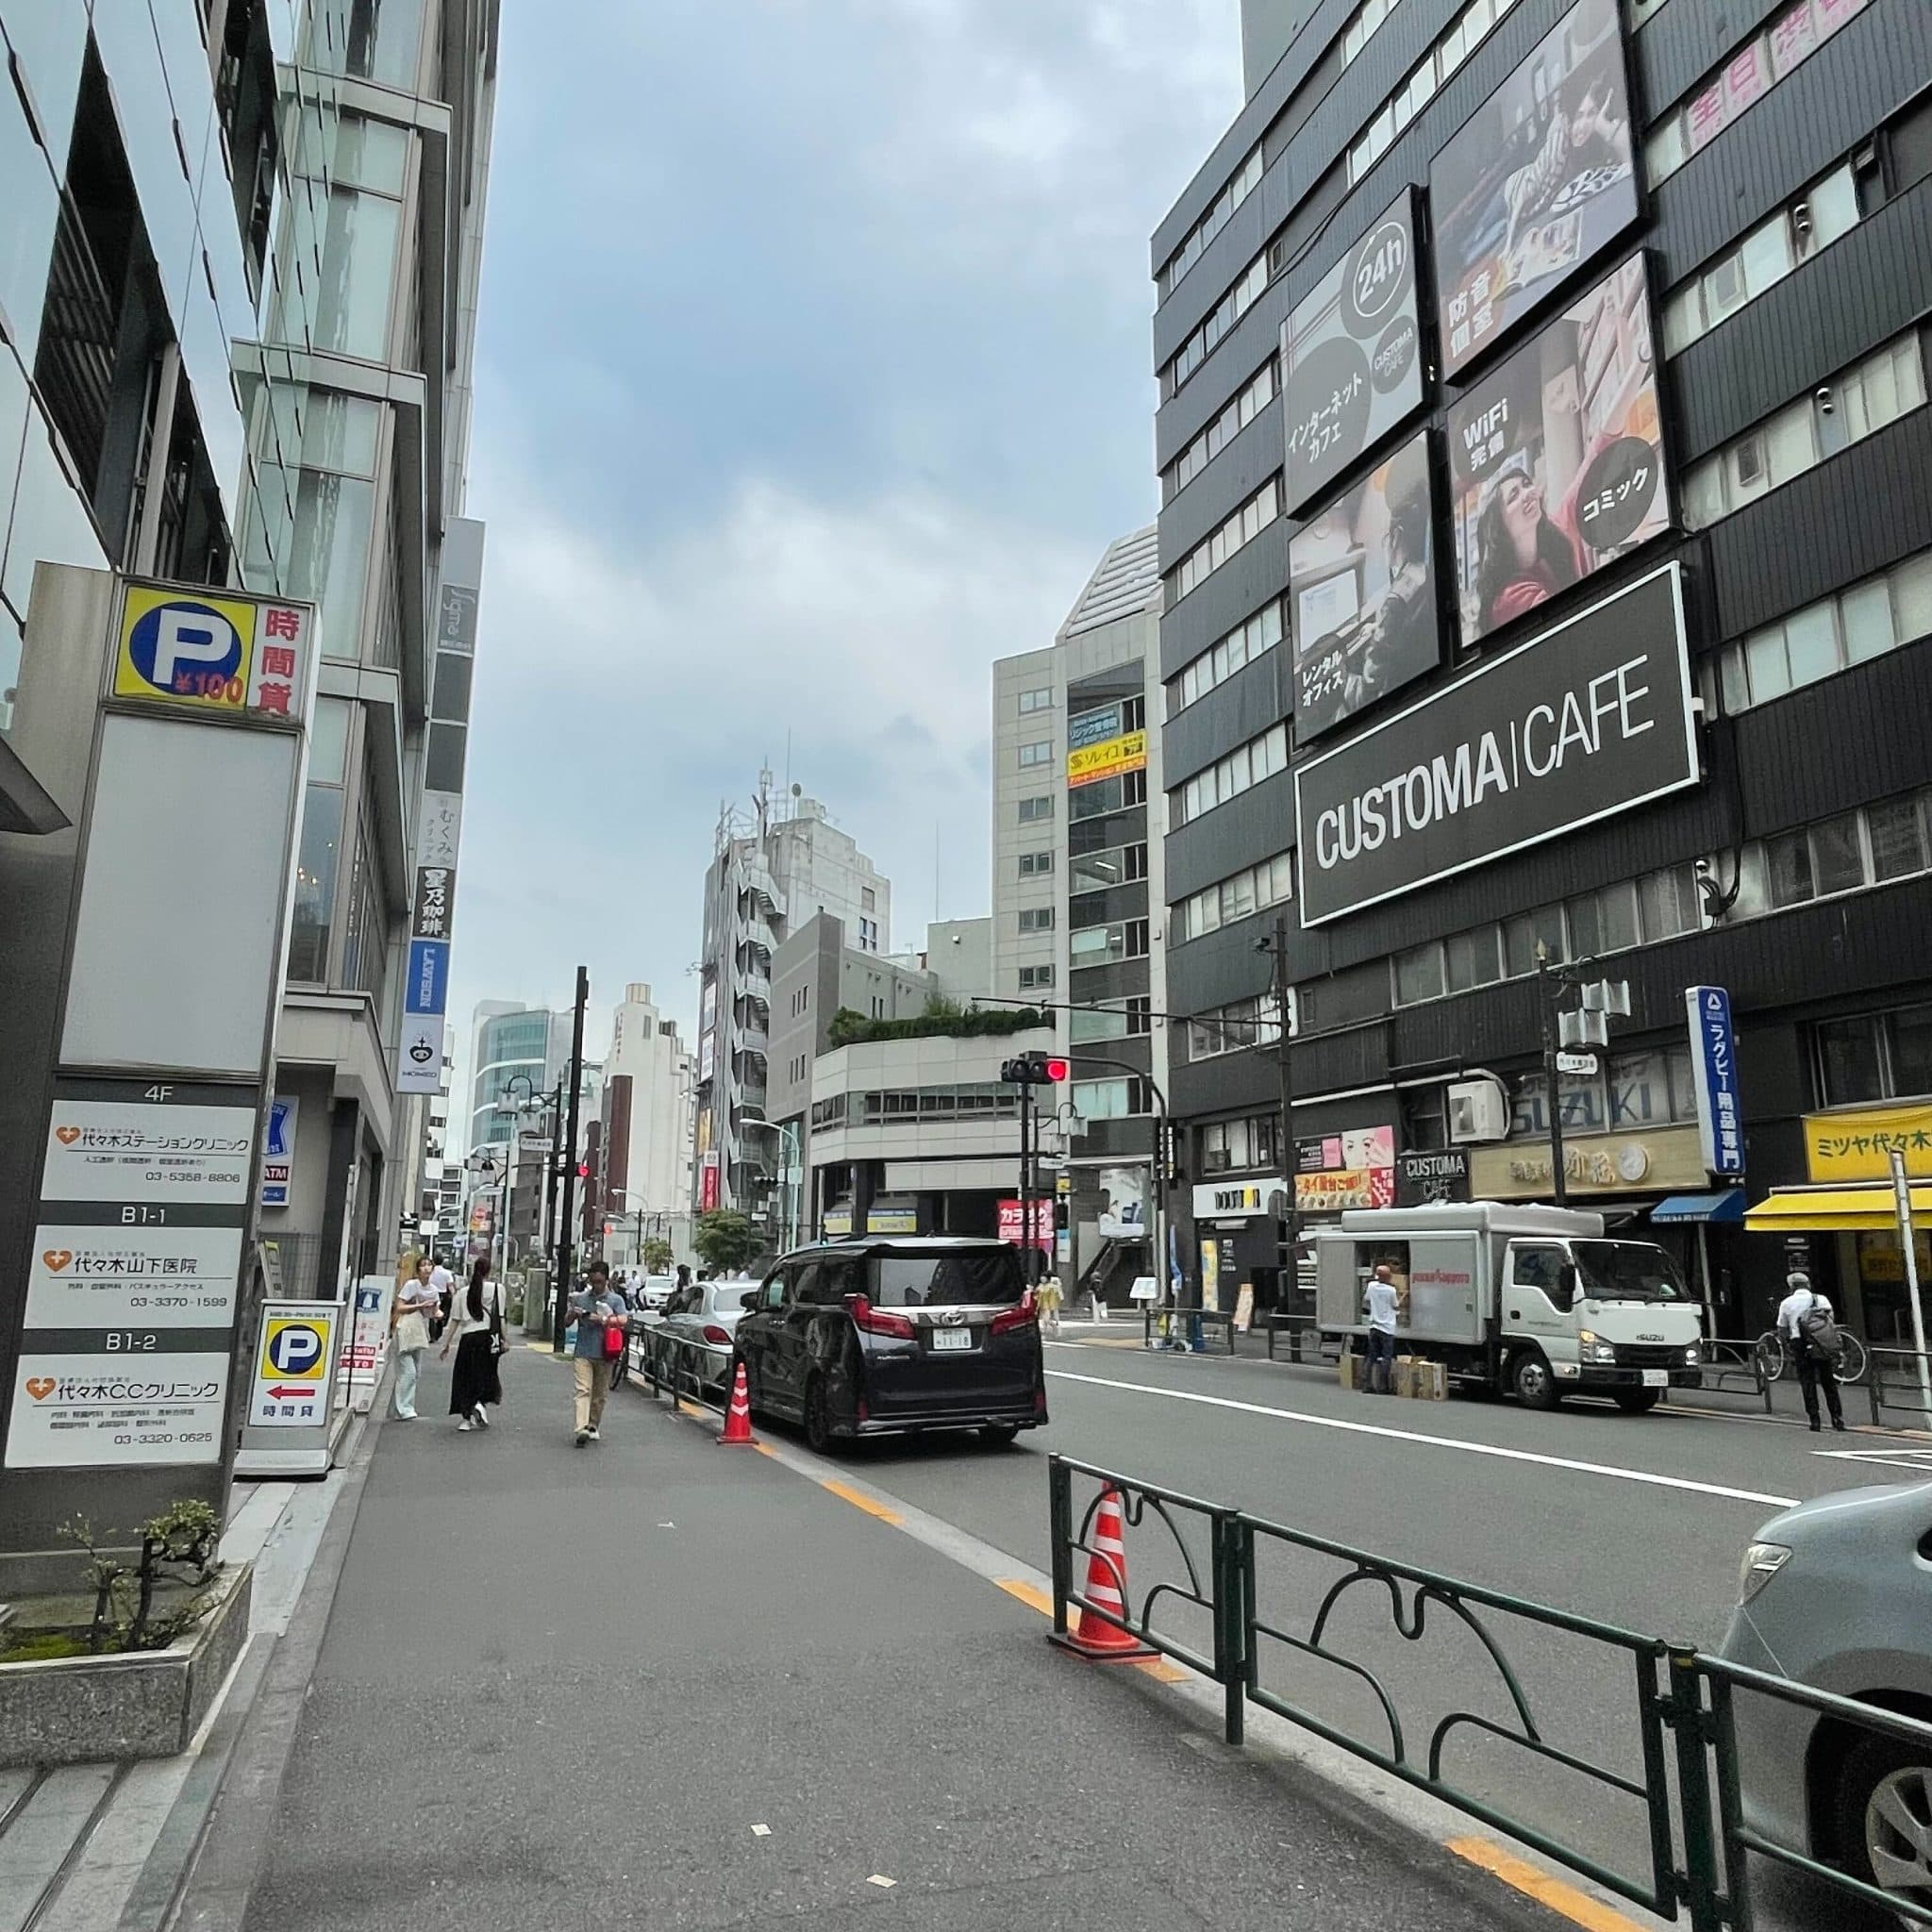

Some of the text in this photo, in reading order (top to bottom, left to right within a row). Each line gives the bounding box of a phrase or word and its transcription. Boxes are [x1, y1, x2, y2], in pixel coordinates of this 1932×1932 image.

[1358, 238, 1403, 304] 24h
[1448, 271, 1491, 327] 防音
[1288, 372, 1362, 454] インターネット
[1463, 398, 1508, 449] WiFi
[1308, 422, 1342, 463] カフェ
[1471, 430, 1505, 472] 完備
[1583, 467, 1648, 522] コミック
[154, 608, 233, 686] P
[258, 608, 300, 716] 時間貸
[1303, 650, 1342, 689] レンタル
[1303, 670, 1344, 707] オフィス
[1316, 654, 1656, 870] CUSTOMA CAFE
[420, 868, 448, 936] 星乃珈琲
[420, 947, 436, 1008] LAWSON
[144, 1086, 174, 1101] 4F
[1710, 1024, 1740, 1170] ラグビー用品専門
[82, 1134, 249, 1152] 代々木ステーションクリニック
[265, 1168, 288, 1179] ATM
[1406, 1154, 1465, 1178] CUSTOMA
[122, 1207, 166, 1224] B1-1
[75, 1257, 197, 1274] 代々木山下医院
[130, 1297, 227, 1307] 03-3370-1599
[106, 1333, 157, 1350] B1-2
[277, 1330, 318, 1369] P
[1636, 1333, 1665, 1342] ISUZU
[262, 1405, 313, 1417] 時間貸
[114, 1433, 212, 1445] 03-3320-0625
